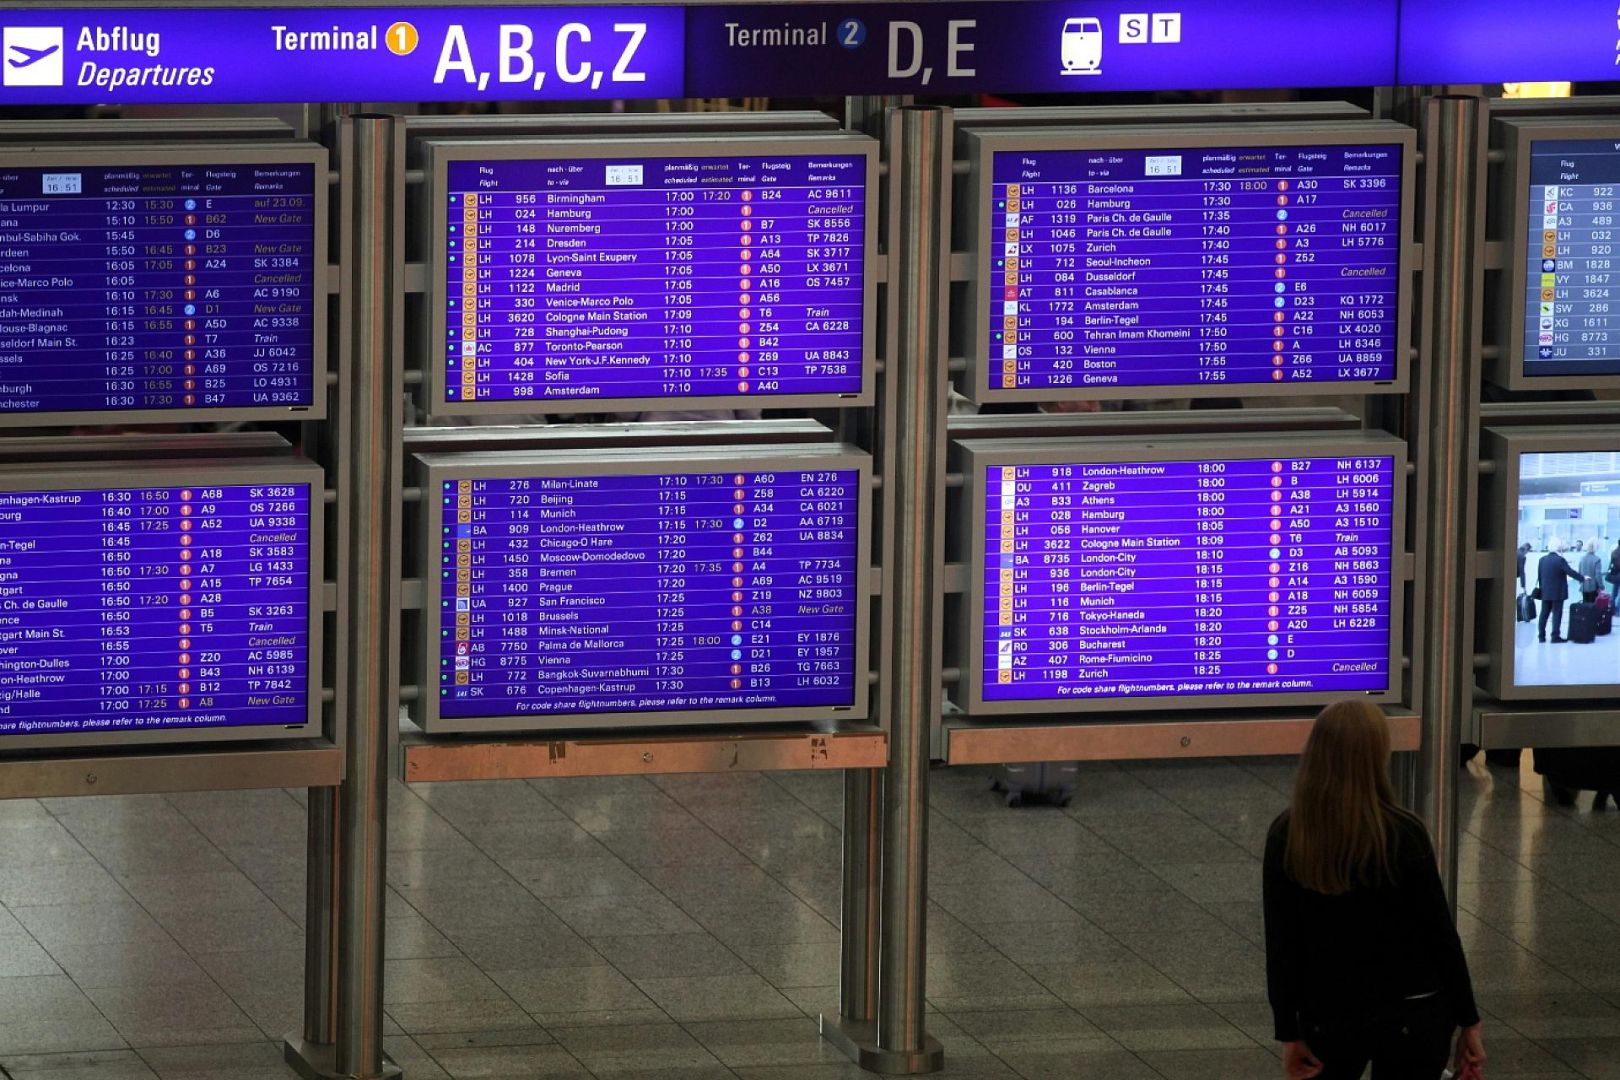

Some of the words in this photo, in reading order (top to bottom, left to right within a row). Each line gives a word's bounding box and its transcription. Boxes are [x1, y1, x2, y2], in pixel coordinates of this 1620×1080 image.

[725, 22, 826, 46] Terminal
[1126, 19, 1141, 37] S
[1159, 19, 1174, 37] T
[76, 26, 160, 57] Abflug
[271, 25, 377, 50] Terminal
[77, 61, 215, 92] Departures
[1022, 186, 1034, 194] LH
[1052, 184, 1077, 194] 1136
[1088, 184, 1133, 193] Barcelona
[1204, 181, 1231, 191] 17:30
[1240, 181, 1267, 190] 18:00
[1297, 179, 1318, 189] A30
[1343, 179, 1356, 188] SK
[1360, 178, 1386, 188] 3396
[1560, 186, 1573, 196] KC
[1593, 187, 1613, 195] 922
[479, 194, 492, 204] LH
[515, 194, 536, 203] 956
[547, 193, 605, 204] Birmingham
[666, 191, 694, 201] 17:00
[703, 190, 730, 200] 17:20
[761, 190, 781, 199] B24
[807, 189, 821, 198] AC
[825, 188, 850, 198] 9611
[1020, 230, 1033, 238] LH
[1050, 228, 1075, 238] 1046
[1086, 228, 1109, 237] Paris
[1128, 227, 1140, 236] de
[1142, 226, 1171, 236] Gaulle
[1202, 225, 1230, 234] 17:40
[1296, 223, 1316, 232] A26
[1342, 223, 1356, 232] NH
[1360, 222, 1386, 231] 6017
[1557, 260, 1573, 269] BM
[1586, 259, 1610, 269] 1828
[51, 277, 73, 286] Polo
[106, 276, 134, 285] 16:05
[254, 273, 301, 283] Cancelled
[1556, 275, 1569, 283] VY
[1585, 274, 1610, 283] 1847
[1555, 289, 1568, 298] LH
[1583, 288, 1608, 298] 3624
[478, 313, 490, 322] LH
[508, 312, 534, 322] 3620
[545, 312, 585, 323] Cologne
[587, 311, 610, 320] Main
[613, 310, 647, 320] Station
[664, 309, 691, 319] 17:09
[759, 307, 772, 317] T6
[806, 307, 829, 316] Train
[37, 338, 62, 347] Main
[105, 336, 134, 345] 16:23
[204, 334, 217, 343] T7
[254, 333, 277, 342] Train
[1554, 333, 1568, 342] HG
[1581, 333, 1608, 342] 8773
[477, 358, 490, 367] LH
[513, 357, 534, 366] 404
[545, 357, 567, 365] New
[663, 353, 691, 362] 17:10
[758, 351, 778, 361] Z69
[804, 351, 819, 360] UA
[822, 350, 848, 359] 8843
[1018, 360, 1030, 370] LH
[1052, 360, 1072, 369] 420
[1083, 359, 1116, 368] Boston
[1199, 356, 1225, 365] 17:55
[1292, 354, 1312, 364] Z66
[1338, 353, 1352, 362] UA
[1356, 352, 1382, 362] 8859
[105, 396, 134, 405] 16:30
[204, 394, 225, 403] B47
[253, 392, 268, 402] UA
[271, 391, 299, 401] 9362
[473, 481, 486, 490] LH
[509, 480, 529, 490] 276
[659, 476, 687, 486] 17:10
[696, 475, 723, 484] 17:30
[753, 474, 774, 483] A60
[801, 473, 814, 482] EN
[817, 472, 837, 481] 276
[102, 492, 131, 501] 16:30
[140, 490, 169, 500] 16:50
[201, 489, 222, 498] A68
[249, 488, 263, 497] SK
[267, 487, 294, 496] 3628
[22, 600, 35, 608] de
[37, 598, 68, 608] Gaulle
[100, 596, 130, 606] 16:50
[140, 594, 168, 604] 17:20
[200, 593, 221, 602] A28
[471, 599, 486, 608] UA
[508, 597, 527, 606] 927
[539, 596, 556, 606] San
[559, 596, 605, 605] Francisco
[657, 592, 684, 602] 17:25
[752, 590, 771, 599] Z19
[798, 589, 812, 598] NZ
[816, 589, 842, 598] 9803
[1014, 598, 1027, 608] LH
[1080, 596, 1114, 606] Munich
[1195, 593, 1222, 602] 18:15
[1287, 590, 1308, 600] A18
[1334, 590, 1348, 599] NH
[471, 657, 485, 666] HG
[500, 655, 526, 666] 8775
[538, 655, 570, 664] Vienna
[656, 651, 683, 660] 17:25
[751, 648, 770, 658] D21
[797, 647, 809, 656] EY
[815, 646, 839, 656] 1957
[100, 670, 129, 680] 17:00
[200, 667, 220, 676] B43
[248, 666, 263, 675] NH
[267, 664, 294, 674] 6139
[1013, 671, 1025, 680] LH
[1043, 669, 1067, 678] 1198
[1078, 668, 1108, 678] Zurich
[1193, 665, 1220, 674] 18:25
[1332, 662, 1377, 672] Cancelled
